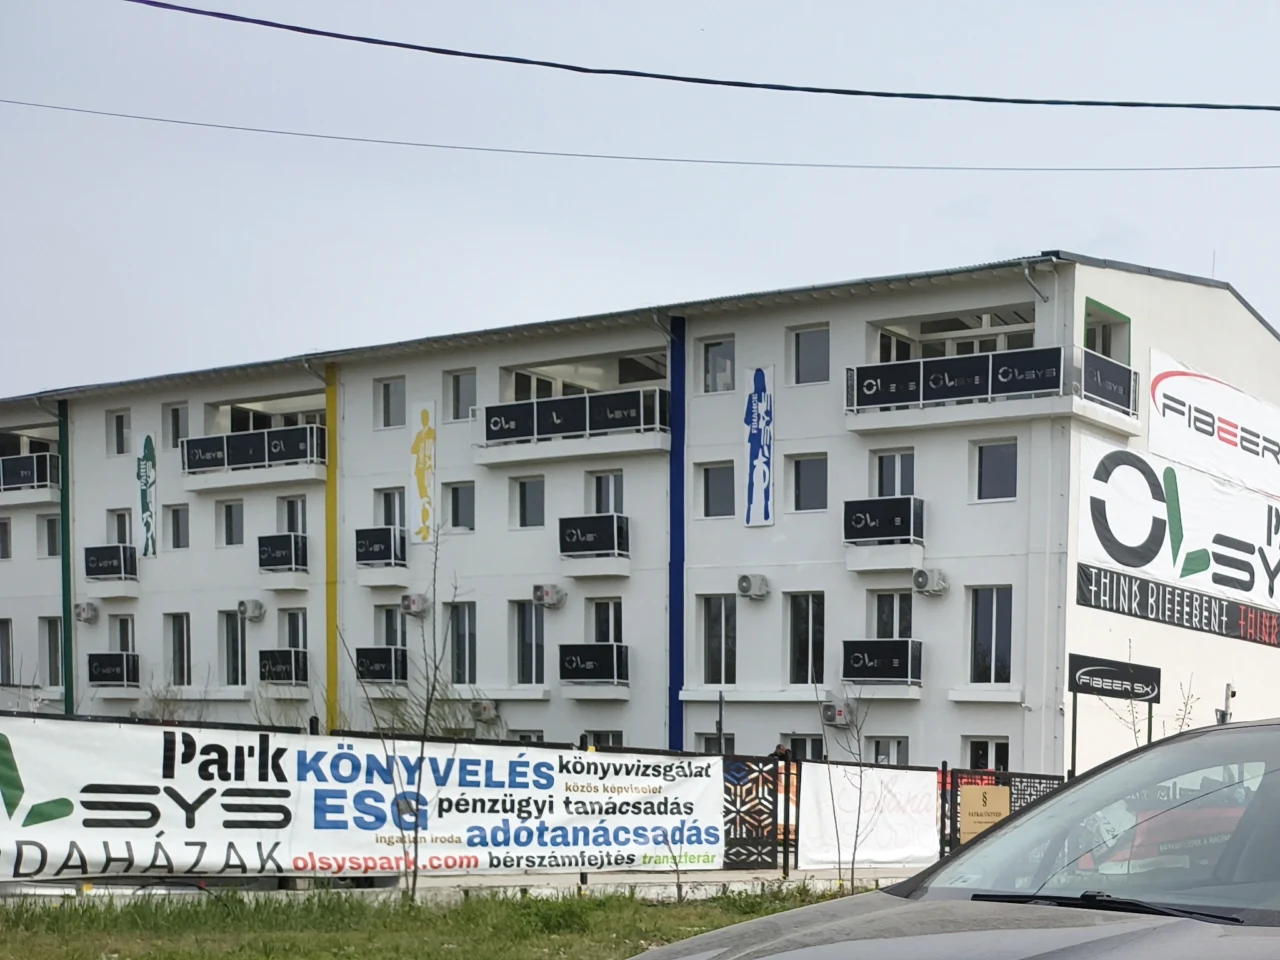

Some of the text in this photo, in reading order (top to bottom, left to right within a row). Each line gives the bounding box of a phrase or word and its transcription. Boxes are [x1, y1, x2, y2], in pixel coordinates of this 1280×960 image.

[1162, 392, 1280, 465] FIBEER
[1080, 675, 1152, 694] FIBEER SX
[162, 730, 289, 783] Park
[296, 743, 555, 790] KÖNYVELÉS
[558, 754, 712, 782] könyvvizsgálat
[564, 782, 600, 794] közös
[313, 788, 429, 831] ESG
[438, 792, 694, 820] pénzügyi tanácsadás
[430, 833, 462, 845] iroda
[466, 818, 720, 847] adótanácsadás
[292, 851, 479, 875] olsyspark.com
[488, 850, 636, 870] bérszámfejtés
[642, 851, 717, 866] transzferár
